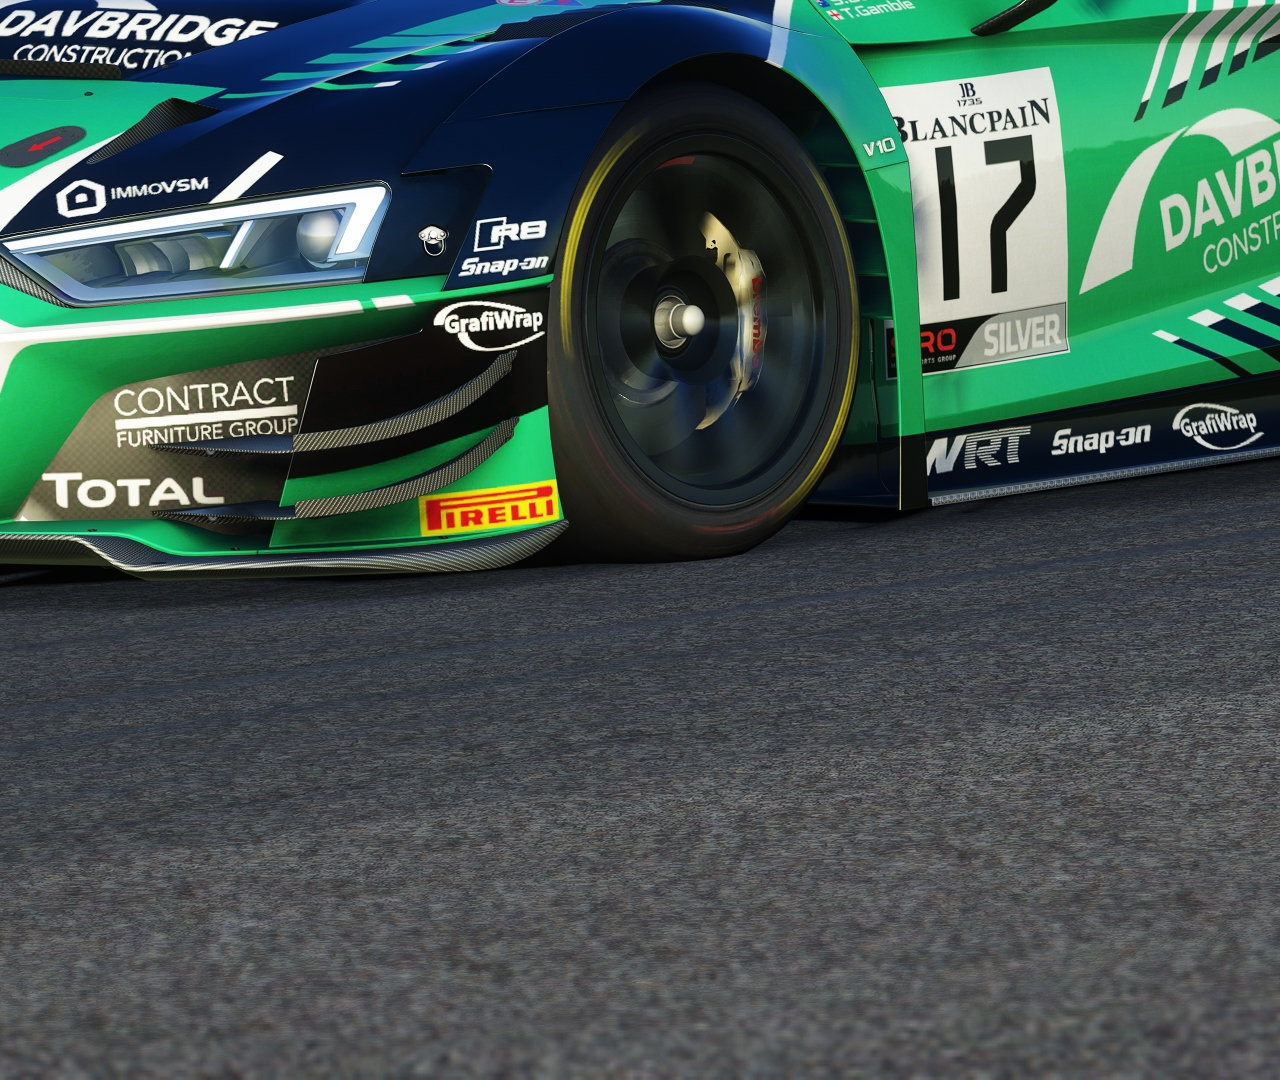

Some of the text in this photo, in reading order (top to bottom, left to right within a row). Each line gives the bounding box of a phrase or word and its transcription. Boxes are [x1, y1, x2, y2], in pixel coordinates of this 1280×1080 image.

[840, 0, 916, 19] T.Gamble
[13, 44, 193, 69] CONSTRUCTIO
[957, 97, 983, 107] 1735
[862, 137, 896, 157] V10
[110, 176, 209, 200] IMMOVSM
[935, 134, 1037, 301] 17
[458, 255, 549, 277] Snap-on
[444, 310, 543, 334] GrafiWrap
[983, 313, 1062, 357] SILVER
[937, 354, 957, 363] GROUP
[113, 376, 295, 416] CONTRACT
[116, 417, 298, 448] FURNITURE GROUP
[1179, 410, 1258, 437] GrafiWrap
[1051, 424, 1152, 455] Snap-on
[42, 472, 224, 509] TOTAL
[425, 486, 556, 531] PIRELLI
